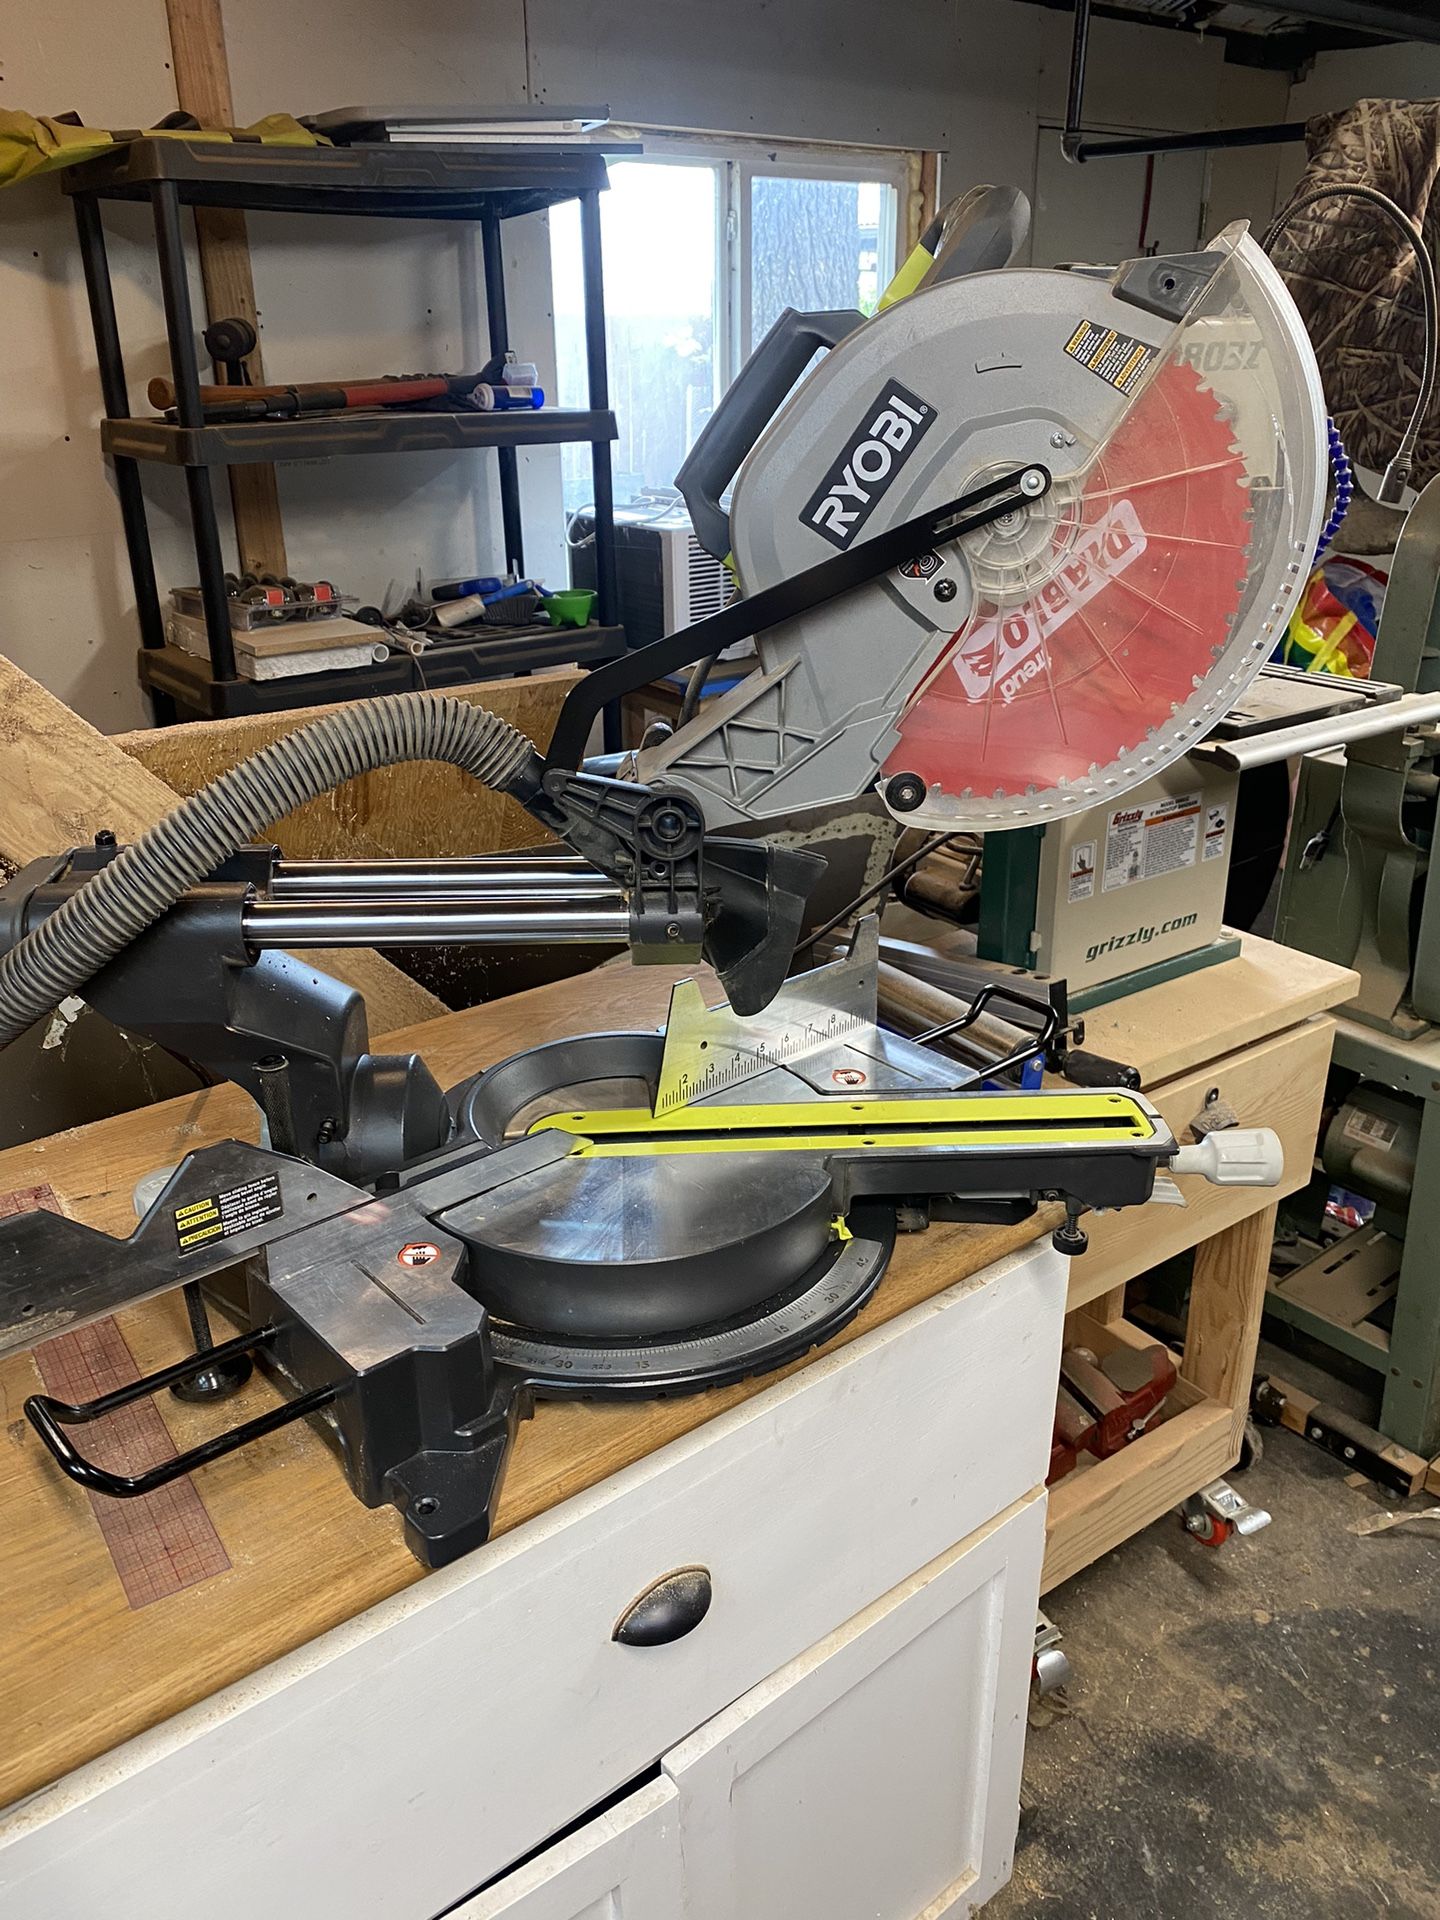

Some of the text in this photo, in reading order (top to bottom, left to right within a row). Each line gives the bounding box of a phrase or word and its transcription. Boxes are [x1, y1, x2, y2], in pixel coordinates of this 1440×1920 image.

[812, 395, 924, 538] RYOBI
[1003, 519, 1135, 649] DIABLO
[1112, 808, 1144, 825] Grizzly
[1085, 912, 1198, 963] grizzly.com
[682, 1014, 836, 1084] 2 3 4 5 6 7 8
[183, 1200, 209, 1214] CAUTION
[185, 1209, 217, 1225] ATTENTION
[555, 1360, 573, 1369] 30
[774, 1325, 789, 1335] 15
[824, 1292, 839, 1304] 30
